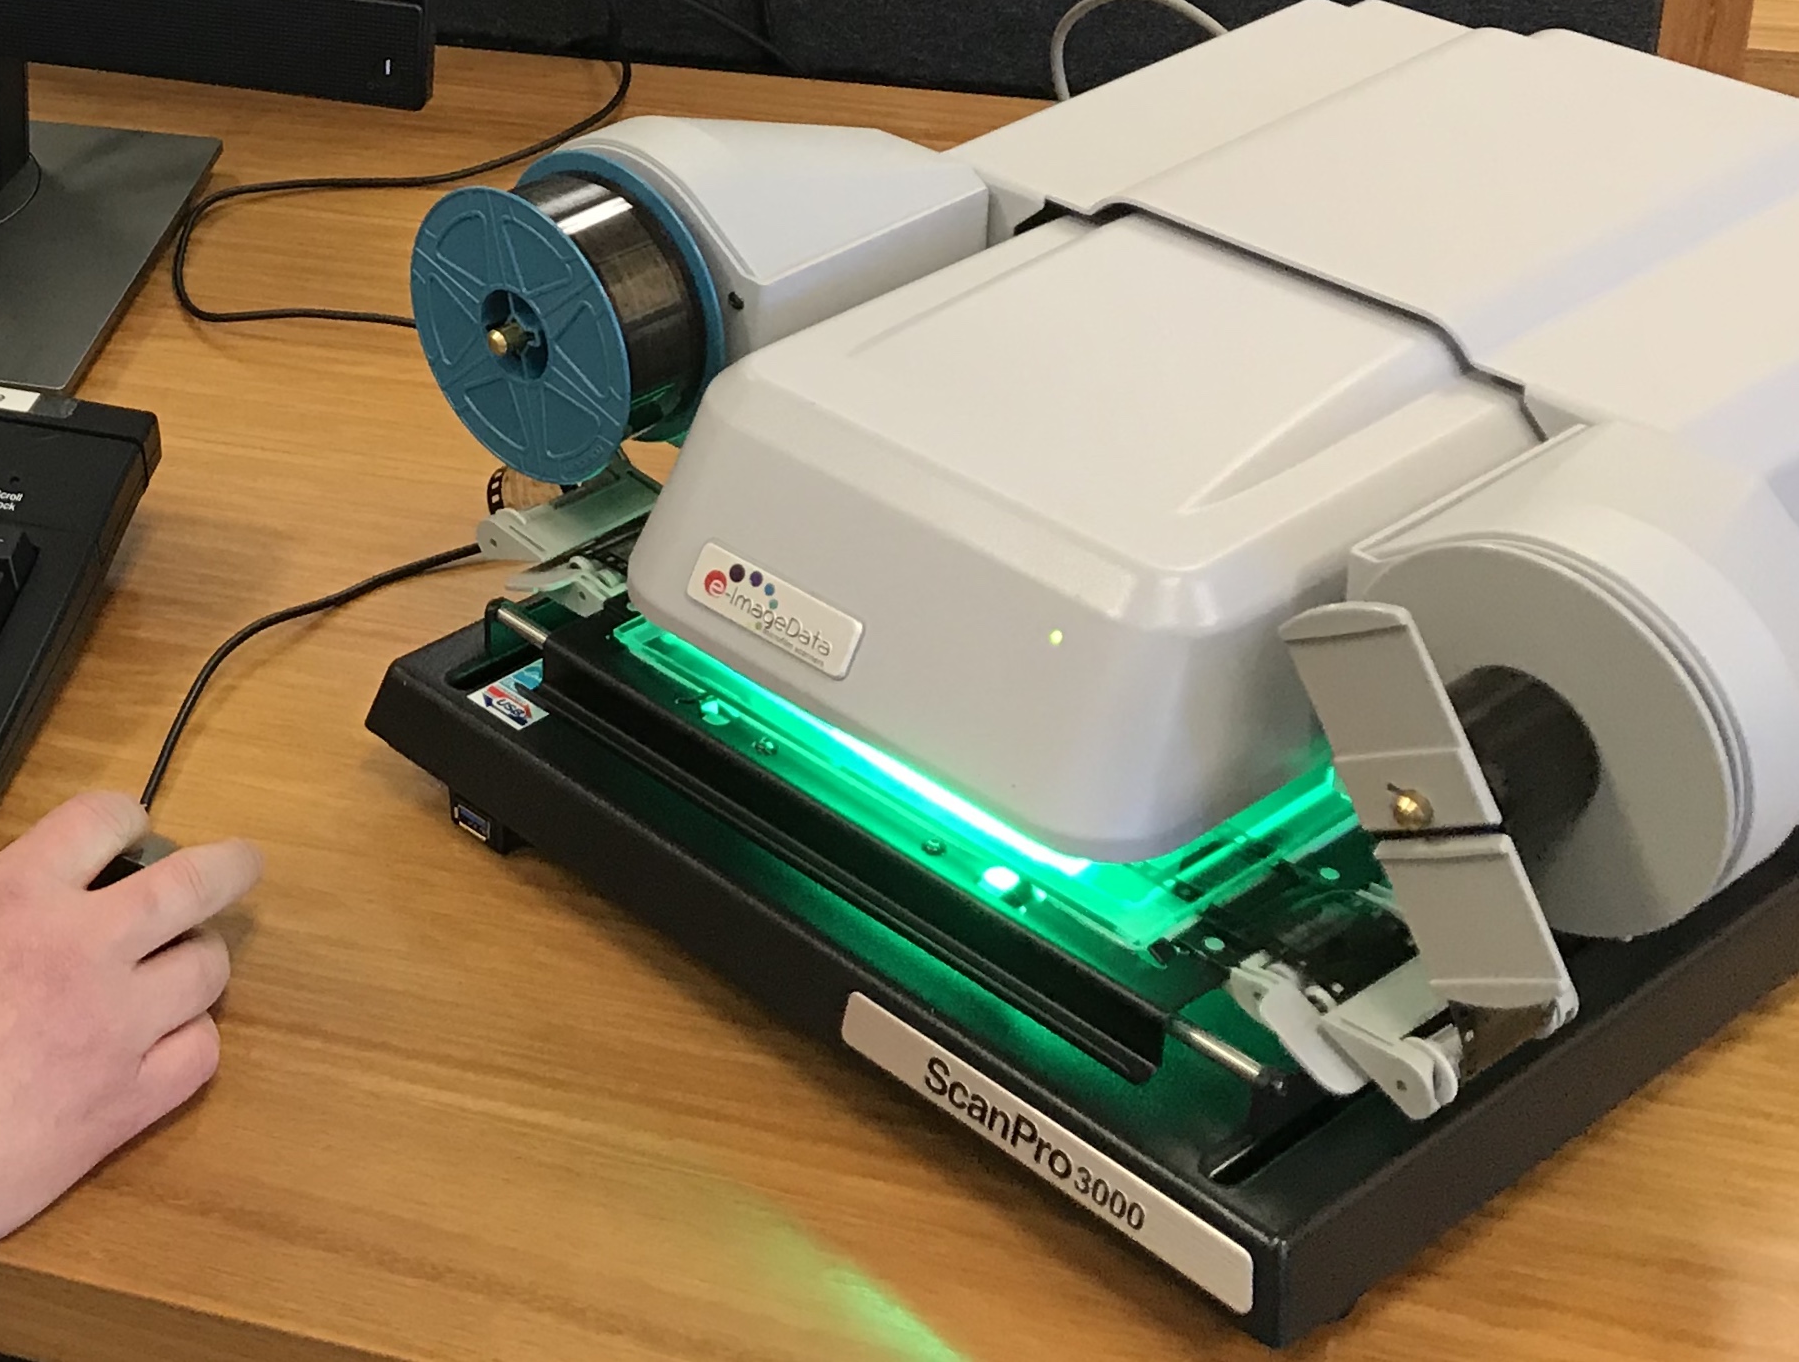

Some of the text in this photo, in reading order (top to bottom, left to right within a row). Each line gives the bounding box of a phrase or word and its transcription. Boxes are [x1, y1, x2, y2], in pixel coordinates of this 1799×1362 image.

[709, 578, 834, 657] e-ImageData
[497, 698, 525, 718] USB
[924, 1056, 1146, 1231] ScanPro 3000
